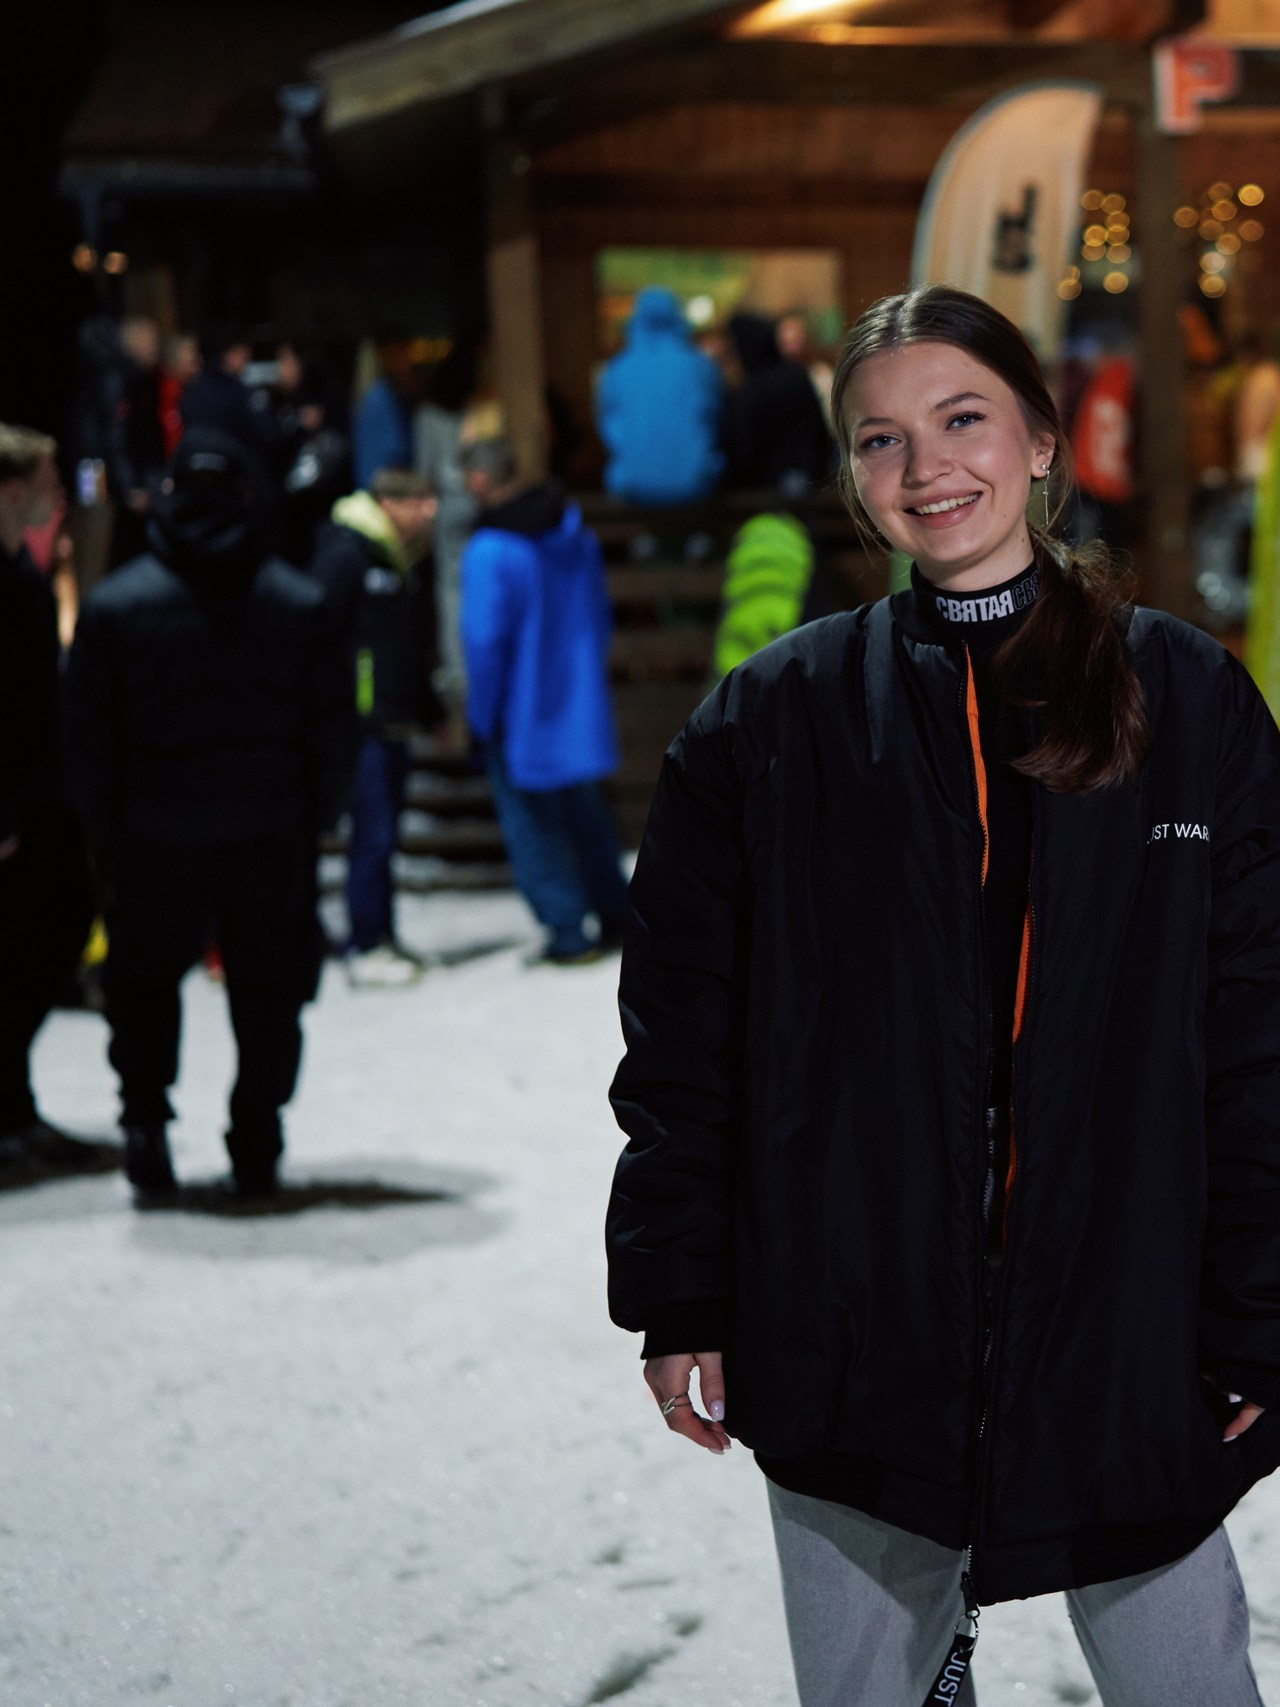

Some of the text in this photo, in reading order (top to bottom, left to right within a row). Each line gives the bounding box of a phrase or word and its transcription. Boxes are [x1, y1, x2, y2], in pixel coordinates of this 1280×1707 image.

[935, 589, 1015, 623] СВЯТАЯ
[1174, 822, 1211, 842] WAR
[934, 1651, 967, 1707] JUST
